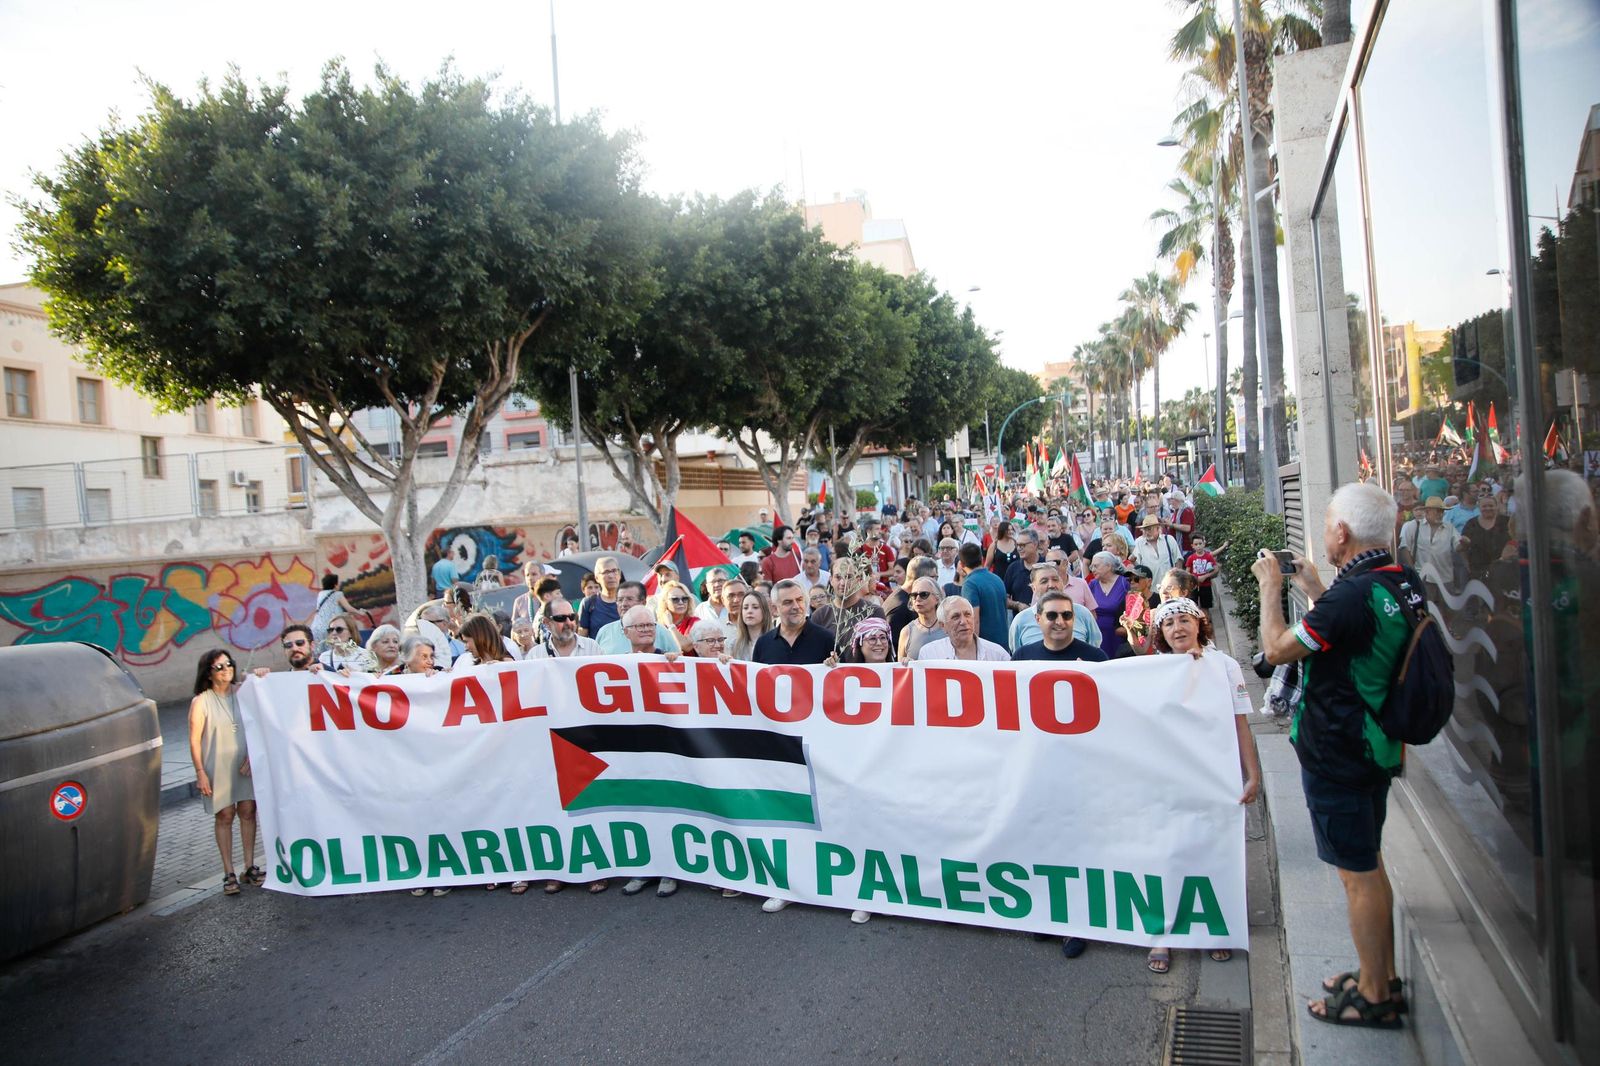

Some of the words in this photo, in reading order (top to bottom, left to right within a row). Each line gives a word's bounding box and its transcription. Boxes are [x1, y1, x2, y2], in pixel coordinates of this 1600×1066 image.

[308, 684, 410, 731] NO
[443, 671, 547, 728] AL
[576, 662, 1101, 735] GENOCIDIO
[275, 821, 651, 888] SOLIDARIDAD
[671, 823, 788, 890] CON
[815, 841, 1230, 937] PALESTINA
